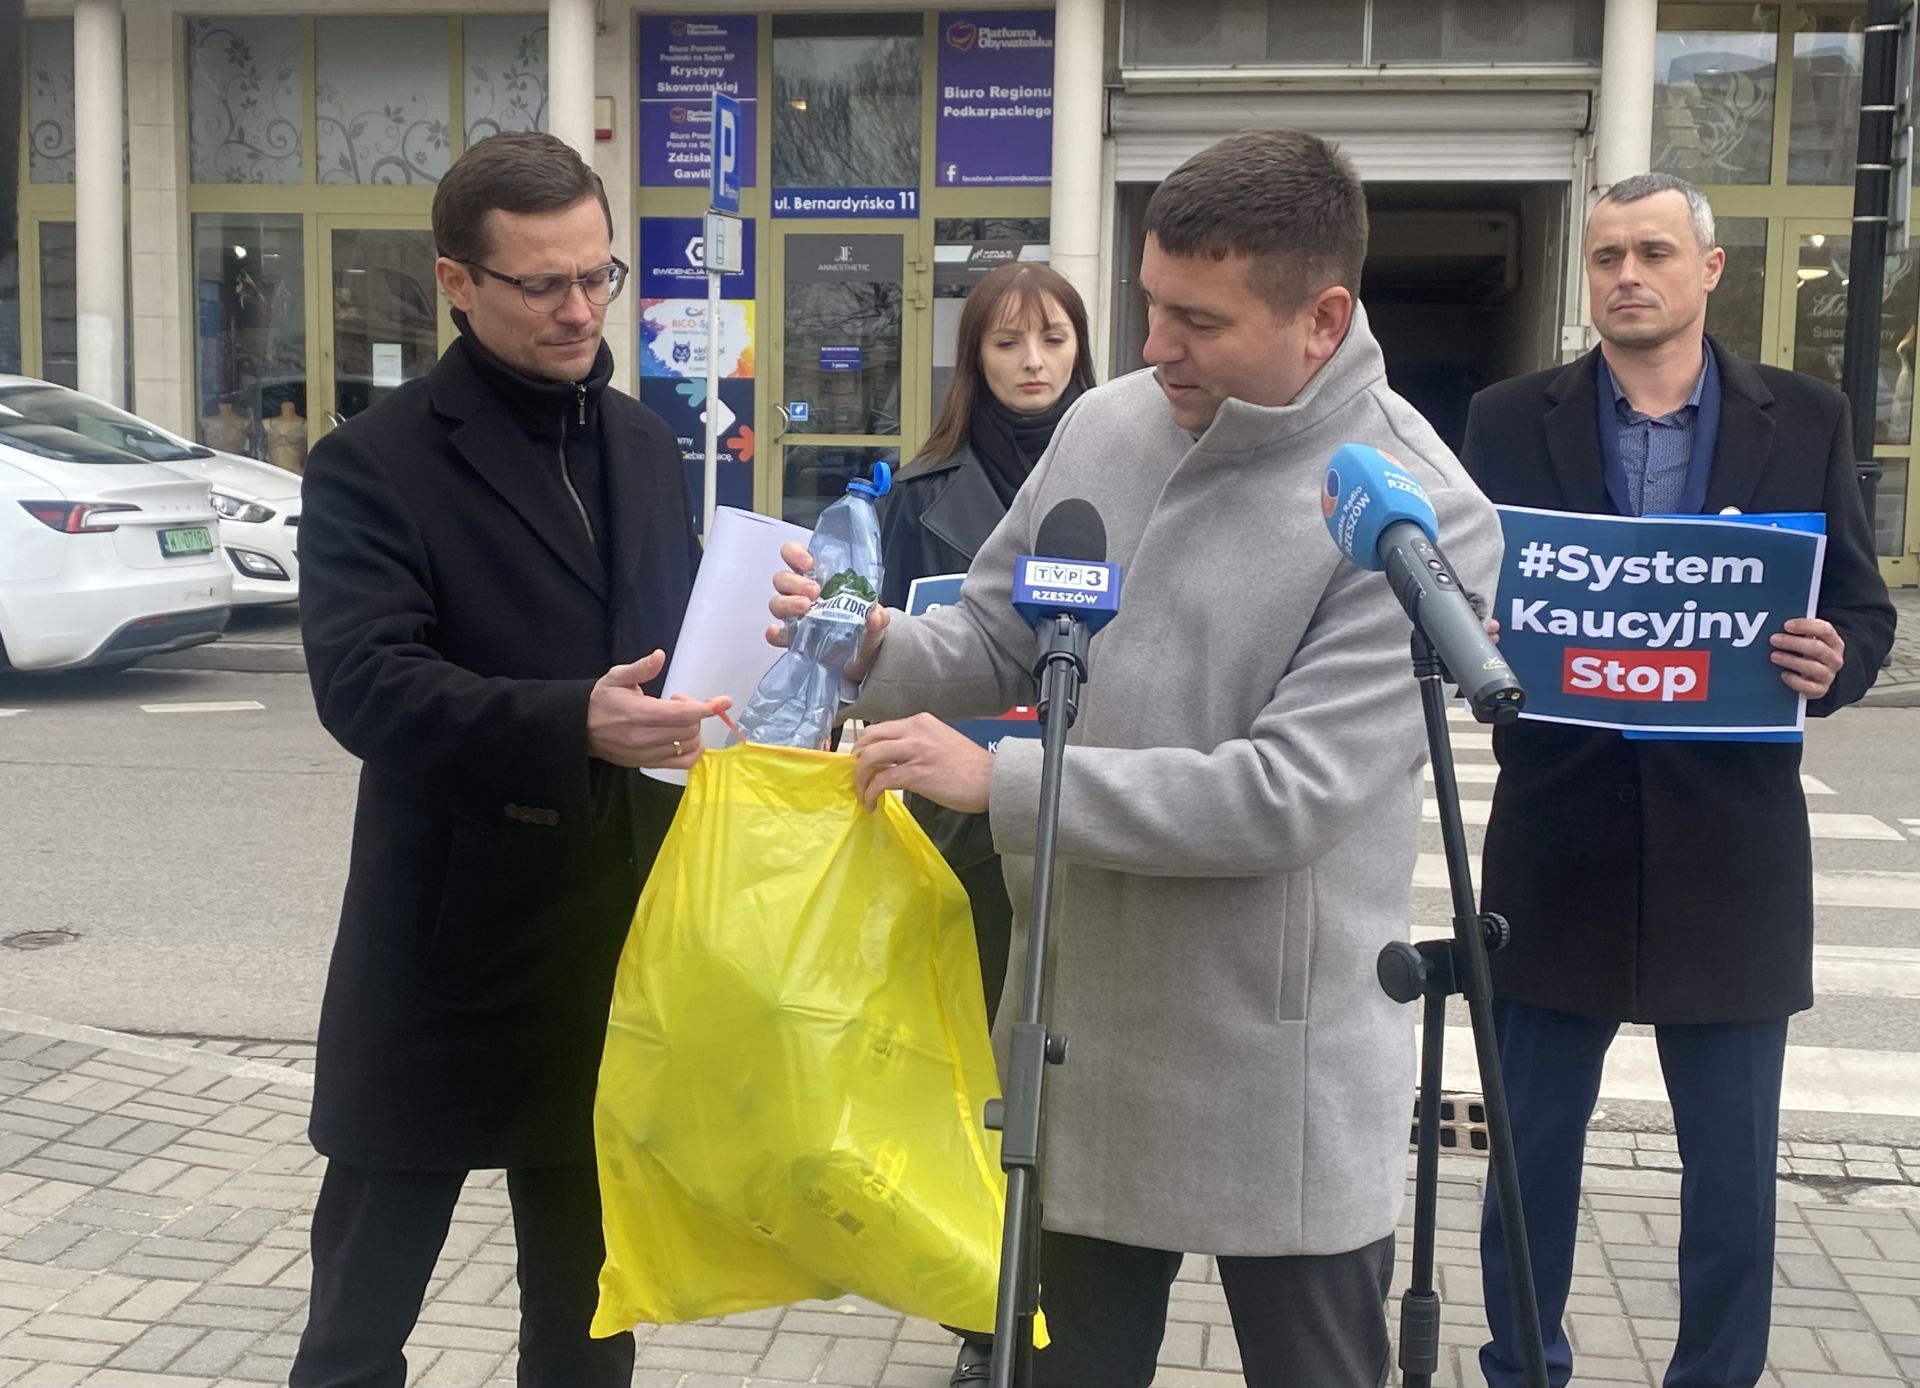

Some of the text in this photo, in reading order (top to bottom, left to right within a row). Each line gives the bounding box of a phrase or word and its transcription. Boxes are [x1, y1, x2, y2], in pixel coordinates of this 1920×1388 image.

[978, 26, 1036, 38] Platforma
[978, 37, 1052, 49] Obywatelska
[670, 66, 725, 77] Krystyny
[657, 81, 738, 94] Skowrońskiej
[944, 86, 1052, 100] Biuro Regionu
[943, 105, 1052, 118] Podkarpackiego
[668, 152, 711, 162] Zdzisła
[720, 108, 736, 196] P
[774, 191, 915, 212] ul. Bernardyńska 11
[1342, 486, 1363, 513] Radio
[1518, 541, 1765, 591] #System
[1037, 566, 1102, 587] TVP 3
[1032, 590, 1098, 605] RZESZÓW
[1511, 598, 1769, 648] Kaucyjny
[1569, 656, 1697, 702] Stop
